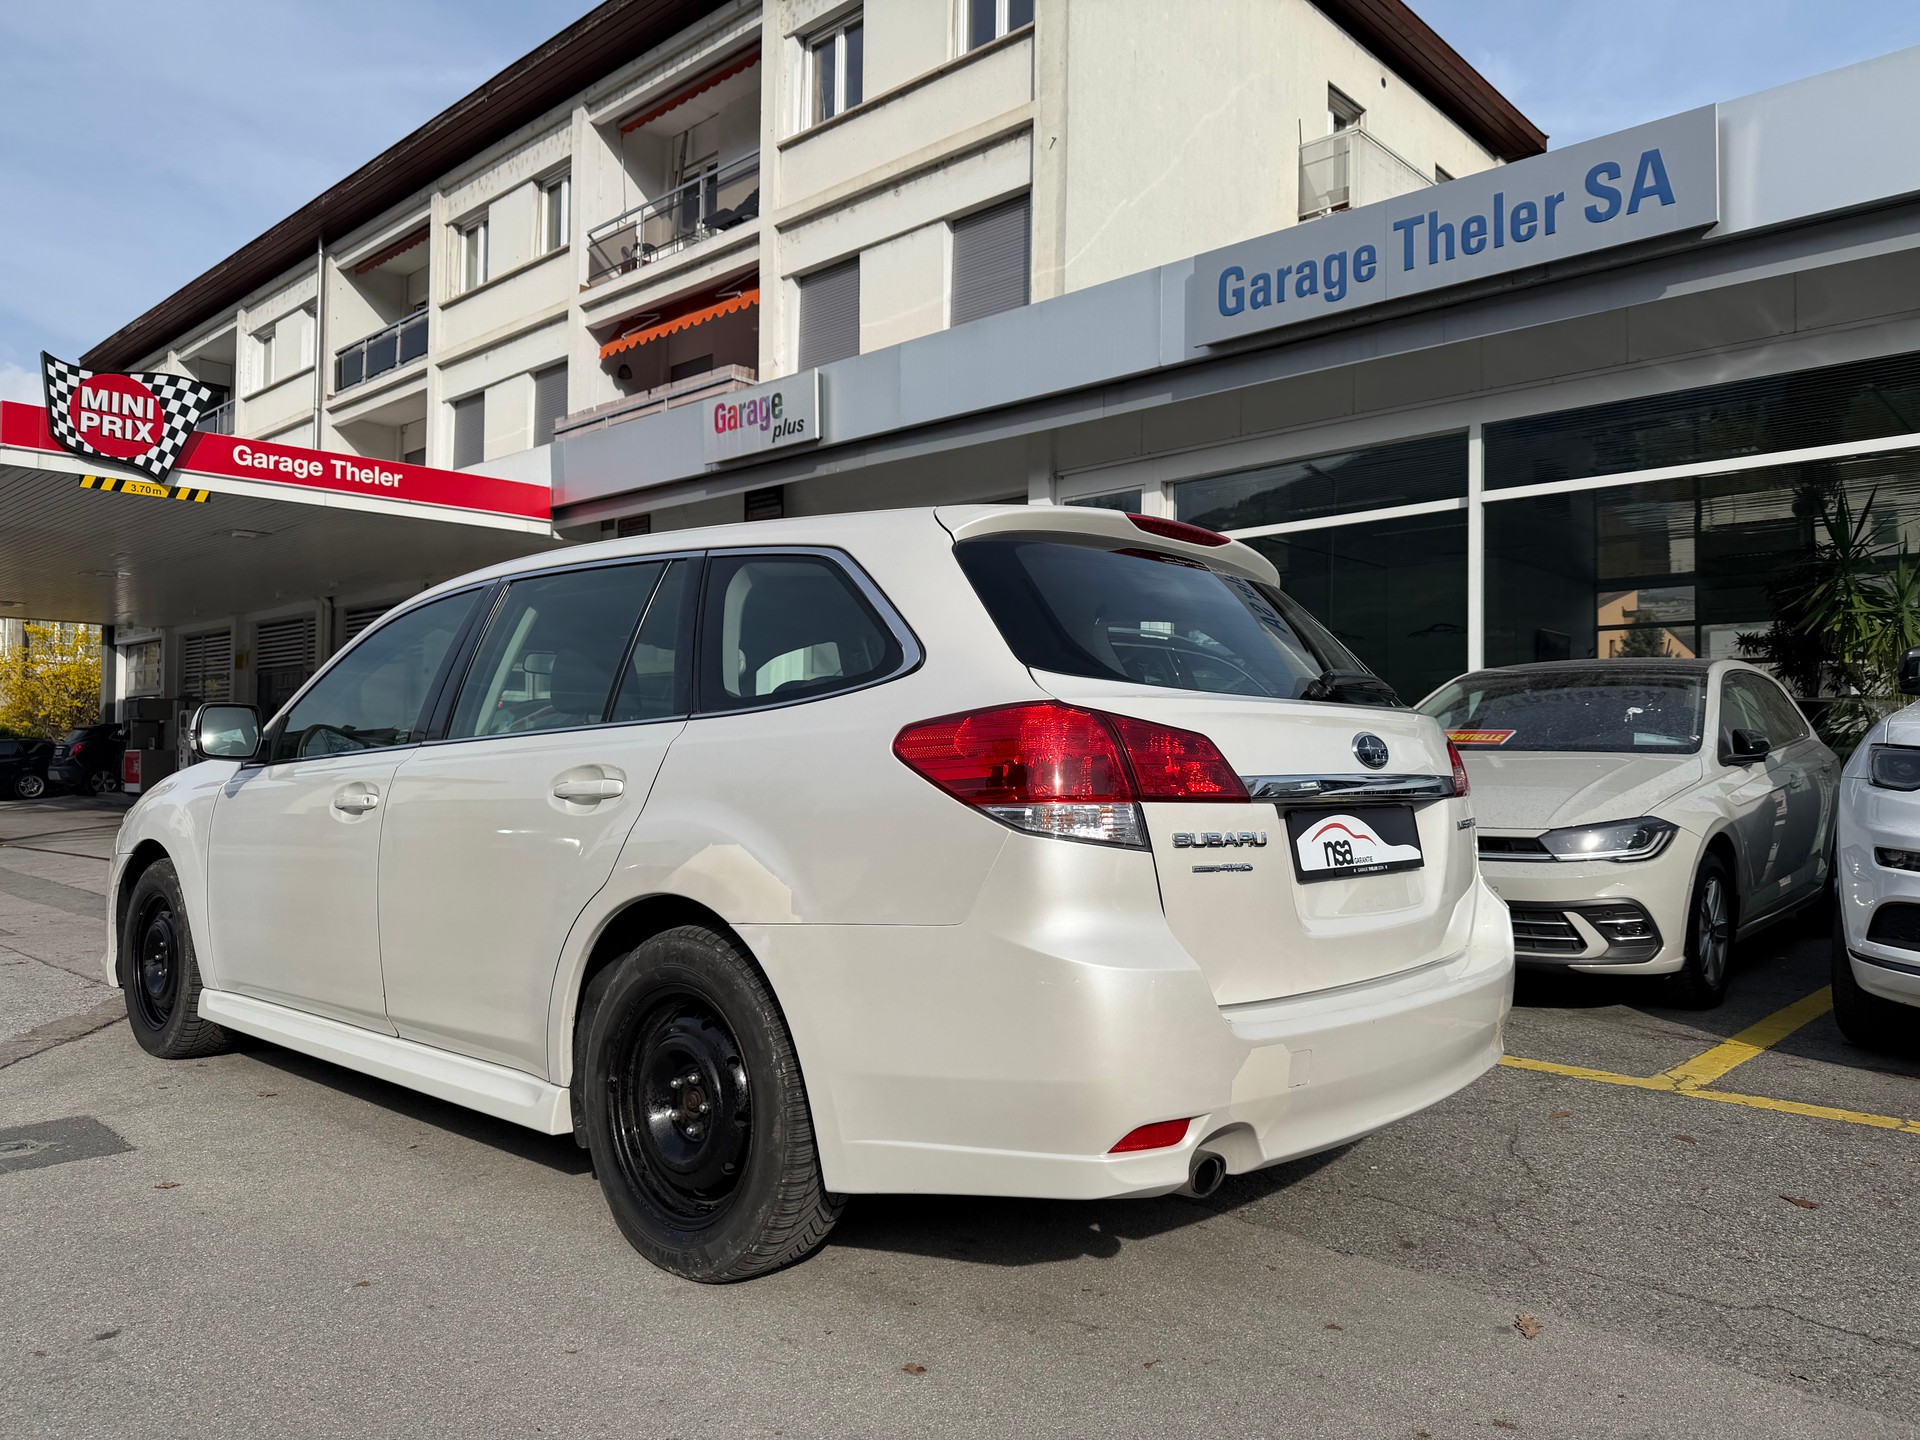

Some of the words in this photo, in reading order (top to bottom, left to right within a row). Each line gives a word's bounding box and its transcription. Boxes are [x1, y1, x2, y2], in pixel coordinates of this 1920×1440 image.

[1218, 243, 1377, 317] Garage
[1393, 191, 1565, 271] Theler
[1584, 148, 1676, 223] SA
[81, 386, 155, 420] MINI
[714, 392, 783, 434] Garage
[80, 411, 155, 444] PRIX
[772, 418, 805, 443] plus
[232, 445, 323, 479] Garage
[330, 459, 404, 488] Theler
[1172, 832, 1267, 848] SUBARU
[1323, 840, 1354, 867] nsa
